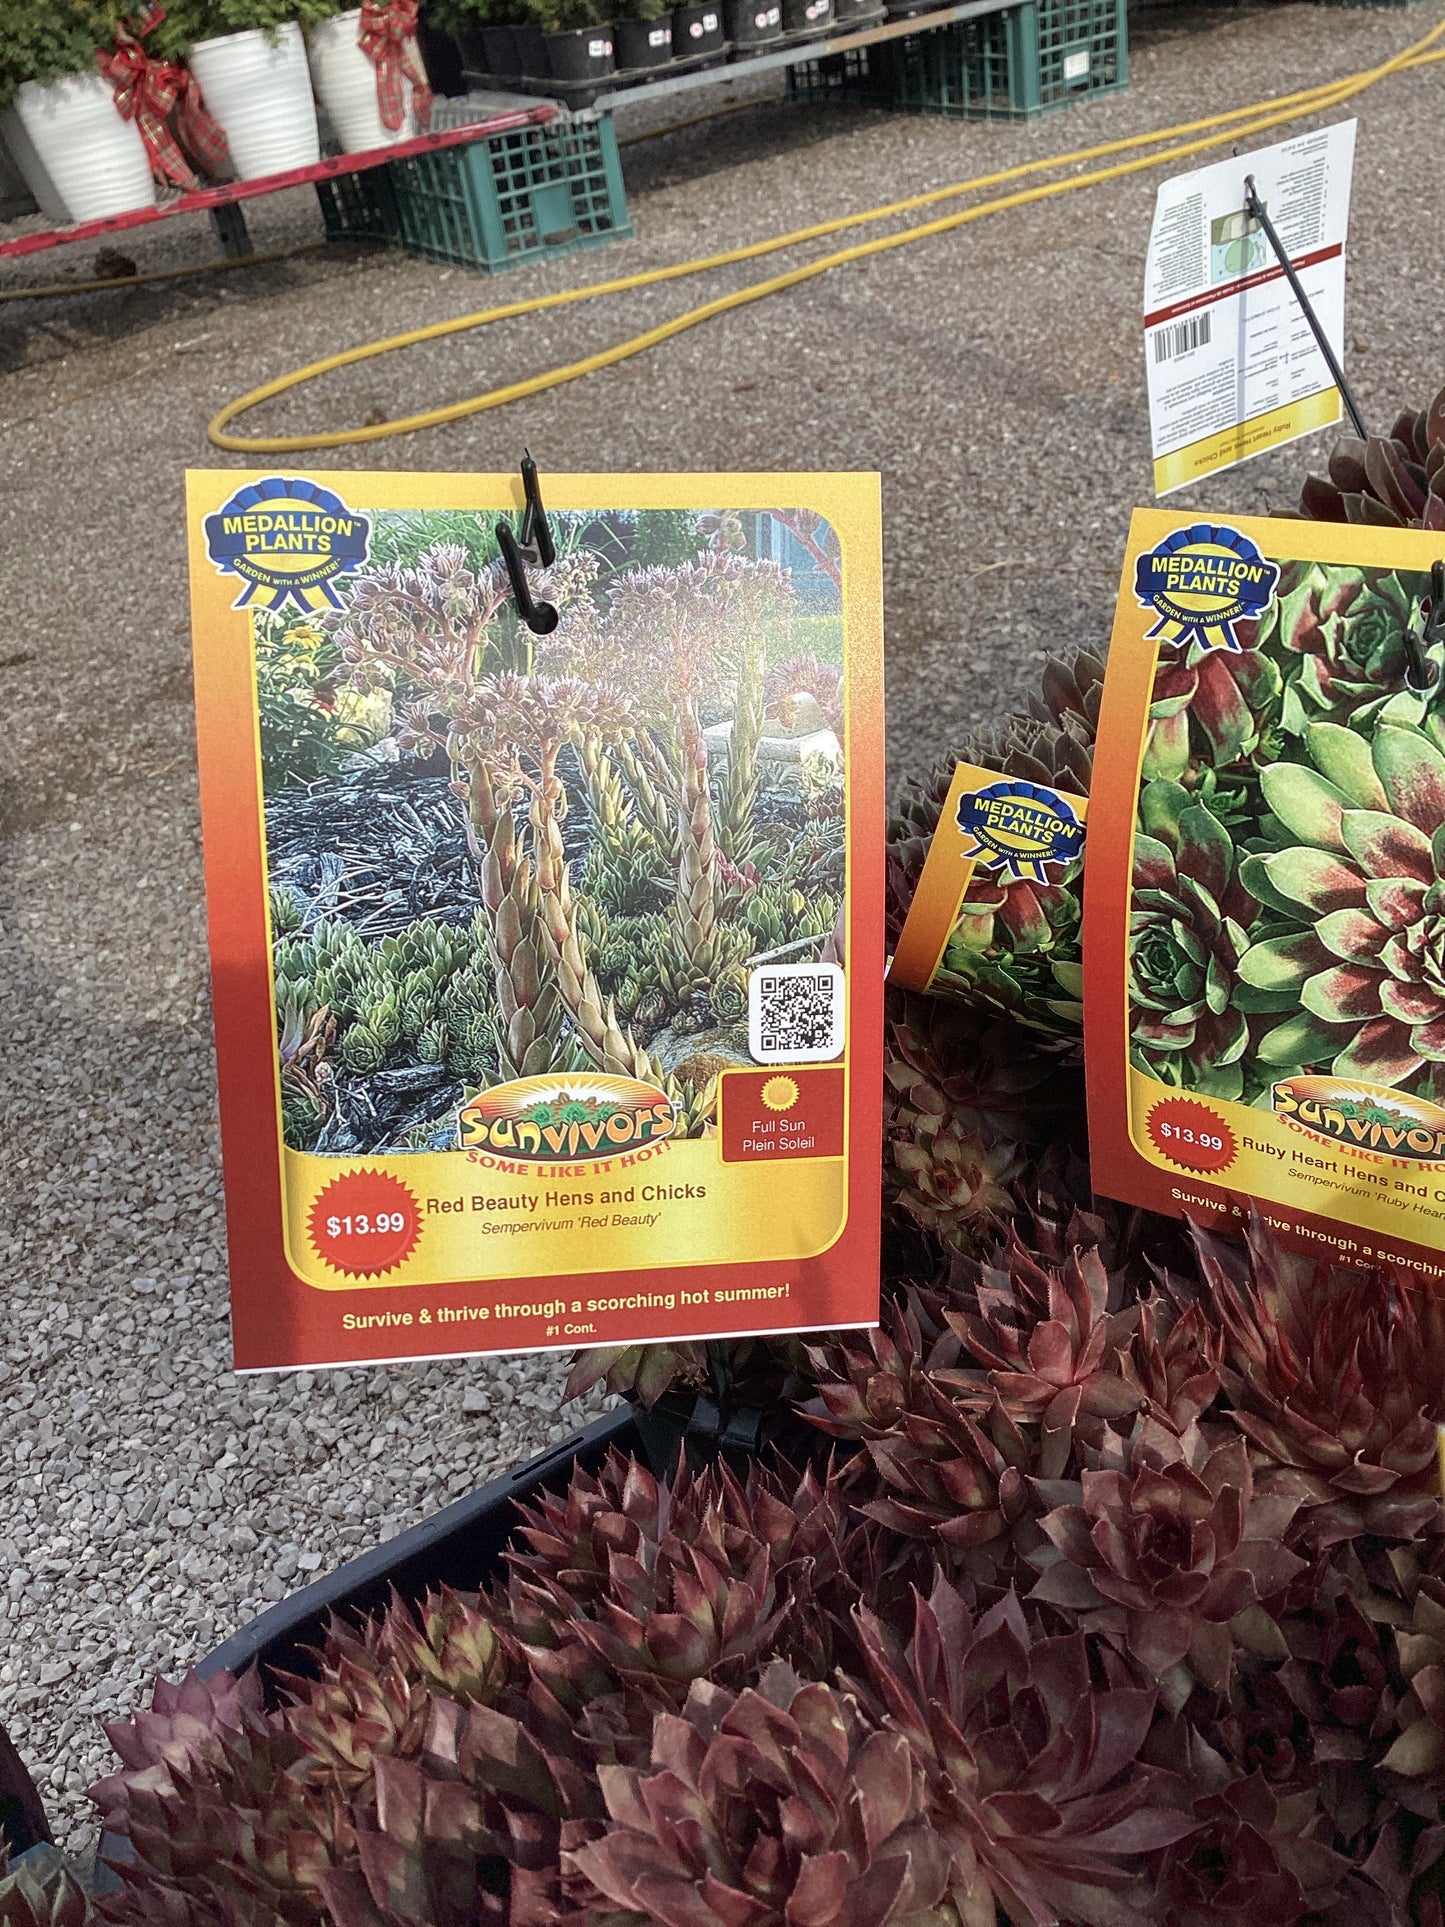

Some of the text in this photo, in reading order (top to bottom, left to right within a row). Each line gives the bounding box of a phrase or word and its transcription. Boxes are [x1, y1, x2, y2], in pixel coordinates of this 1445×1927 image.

[246, 534, 332, 552] PLANTS
[233, 557, 271, 584] GARDEN
[272, 578, 293, 586] WITH
[299, 561, 339, 585] WINNER!
[1167, 574, 1241, 596] PLANTS
[1153, 594, 1182, 619] GARDEN
[1182, 614, 1198, 624] WITH
[1205, 604, 1242, 623] WINNER!
[973, 826, 998, 850] GARDEN
[998, 847, 1013, 856] WITH
[1019, 850, 1054, 859] WINNER!
[987, 814, 1055, 844] PLANTS
[752, 1118, 805, 1133] Full Sun
[1160, 1121, 1224, 1152] $13.99
[742, 1135, 815, 1152] Plein Soleil
[1277, 1114, 1332, 1147] SOME
[1339, 1145, 1385, 1165] LIKE
[1391, 1159, 1411, 1170] IT
[466, 1139, 671, 1178] SOME LIKE IT HOT!
[1242, 1136, 1286, 1160] Ruby
[1292, 1150, 1338, 1173] Heart
[1343, 1163, 1389, 1187] Hens
[1394, 1181, 1428, 1198] and
[427, 1182, 708, 1215] Red Beauty Hens and Chicks
[1288, 1168, 1371, 1198] Sempervivum
[1413, 1205, 1445, 1220] Hear
[326, 1212, 404, 1239] $13.99
[481, 1212, 662, 1236] Sempervivum 'Red Beauty'
[1171, 1187, 1227, 1213] Survive
[1232, 1209, 1242, 1218] &
[1295, 1225, 1358, 1251] through
[1362, 1246, 1372, 1256] a
[1339, 1254, 1351, 1264] #1
[342, 1283, 791, 1331] Survive & thrive through a scorching hot summer!
[546, 1322, 597, 1337] #1 Cont.
